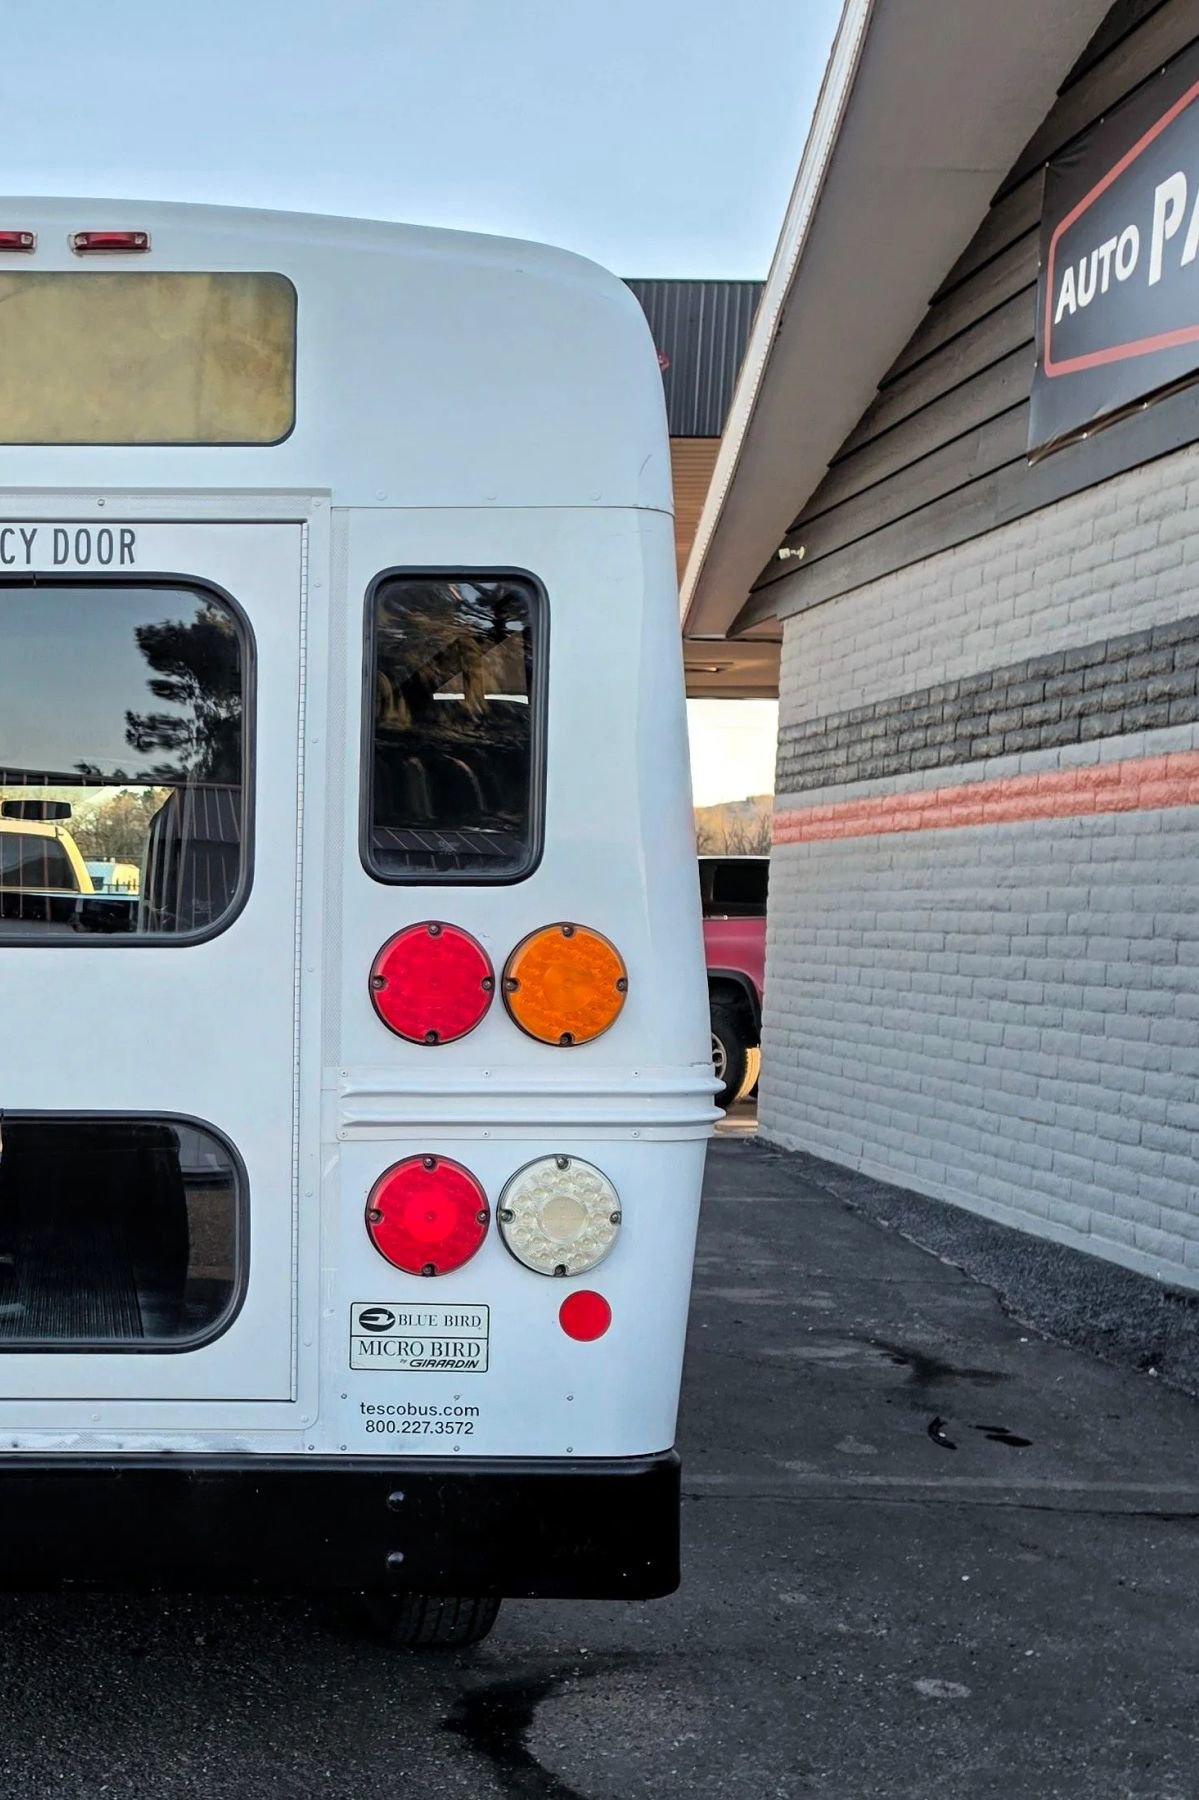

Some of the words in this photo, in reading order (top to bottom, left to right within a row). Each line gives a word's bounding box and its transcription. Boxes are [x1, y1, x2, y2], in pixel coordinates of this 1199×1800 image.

[1054, 224, 1140, 325] AUTO
[53, 528, 136, 566] DOOR
[398, 1314, 438, 1327] BLUE
[444, 1315, 482, 1328] BIRD
[358, 1340, 424, 1357] MICRO
[430, 1341, 481, 1358] BIRD
[410, 1359, 479, 1369] GIRARDIN
[360, 1402, 480, 1416] tescobus.com
[365, 1420, 474, 1434] 800.227.3572
